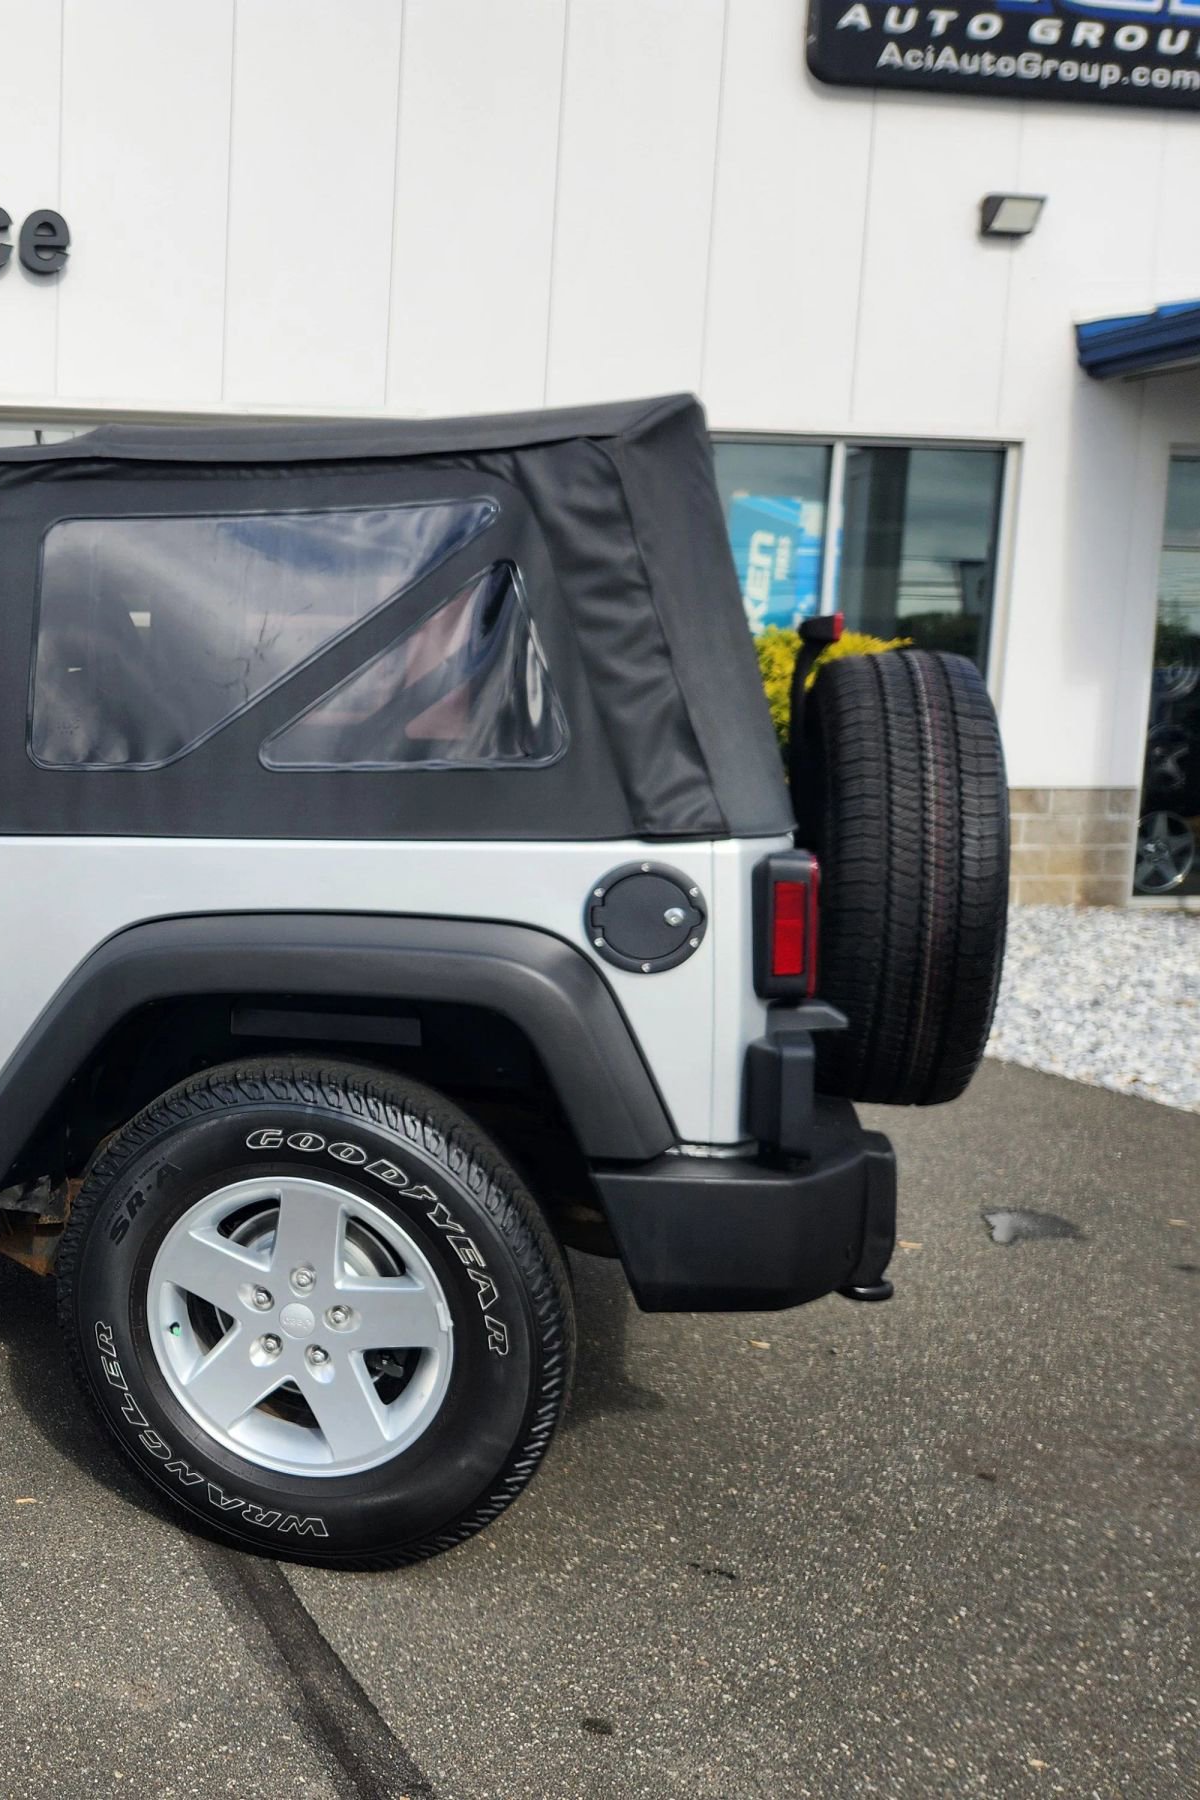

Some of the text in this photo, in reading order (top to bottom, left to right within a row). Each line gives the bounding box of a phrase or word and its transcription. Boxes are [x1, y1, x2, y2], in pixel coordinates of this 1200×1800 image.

[836, 3, 1004, 41] AUTO
[1028, 18, 1200, 58] GROU
[876, 41, 1200, 90] AciAutoGroup.com
[245, 1128, 509, 1357] GOODYEAR
[94, 1321, 330, 1538] WRANGLER
